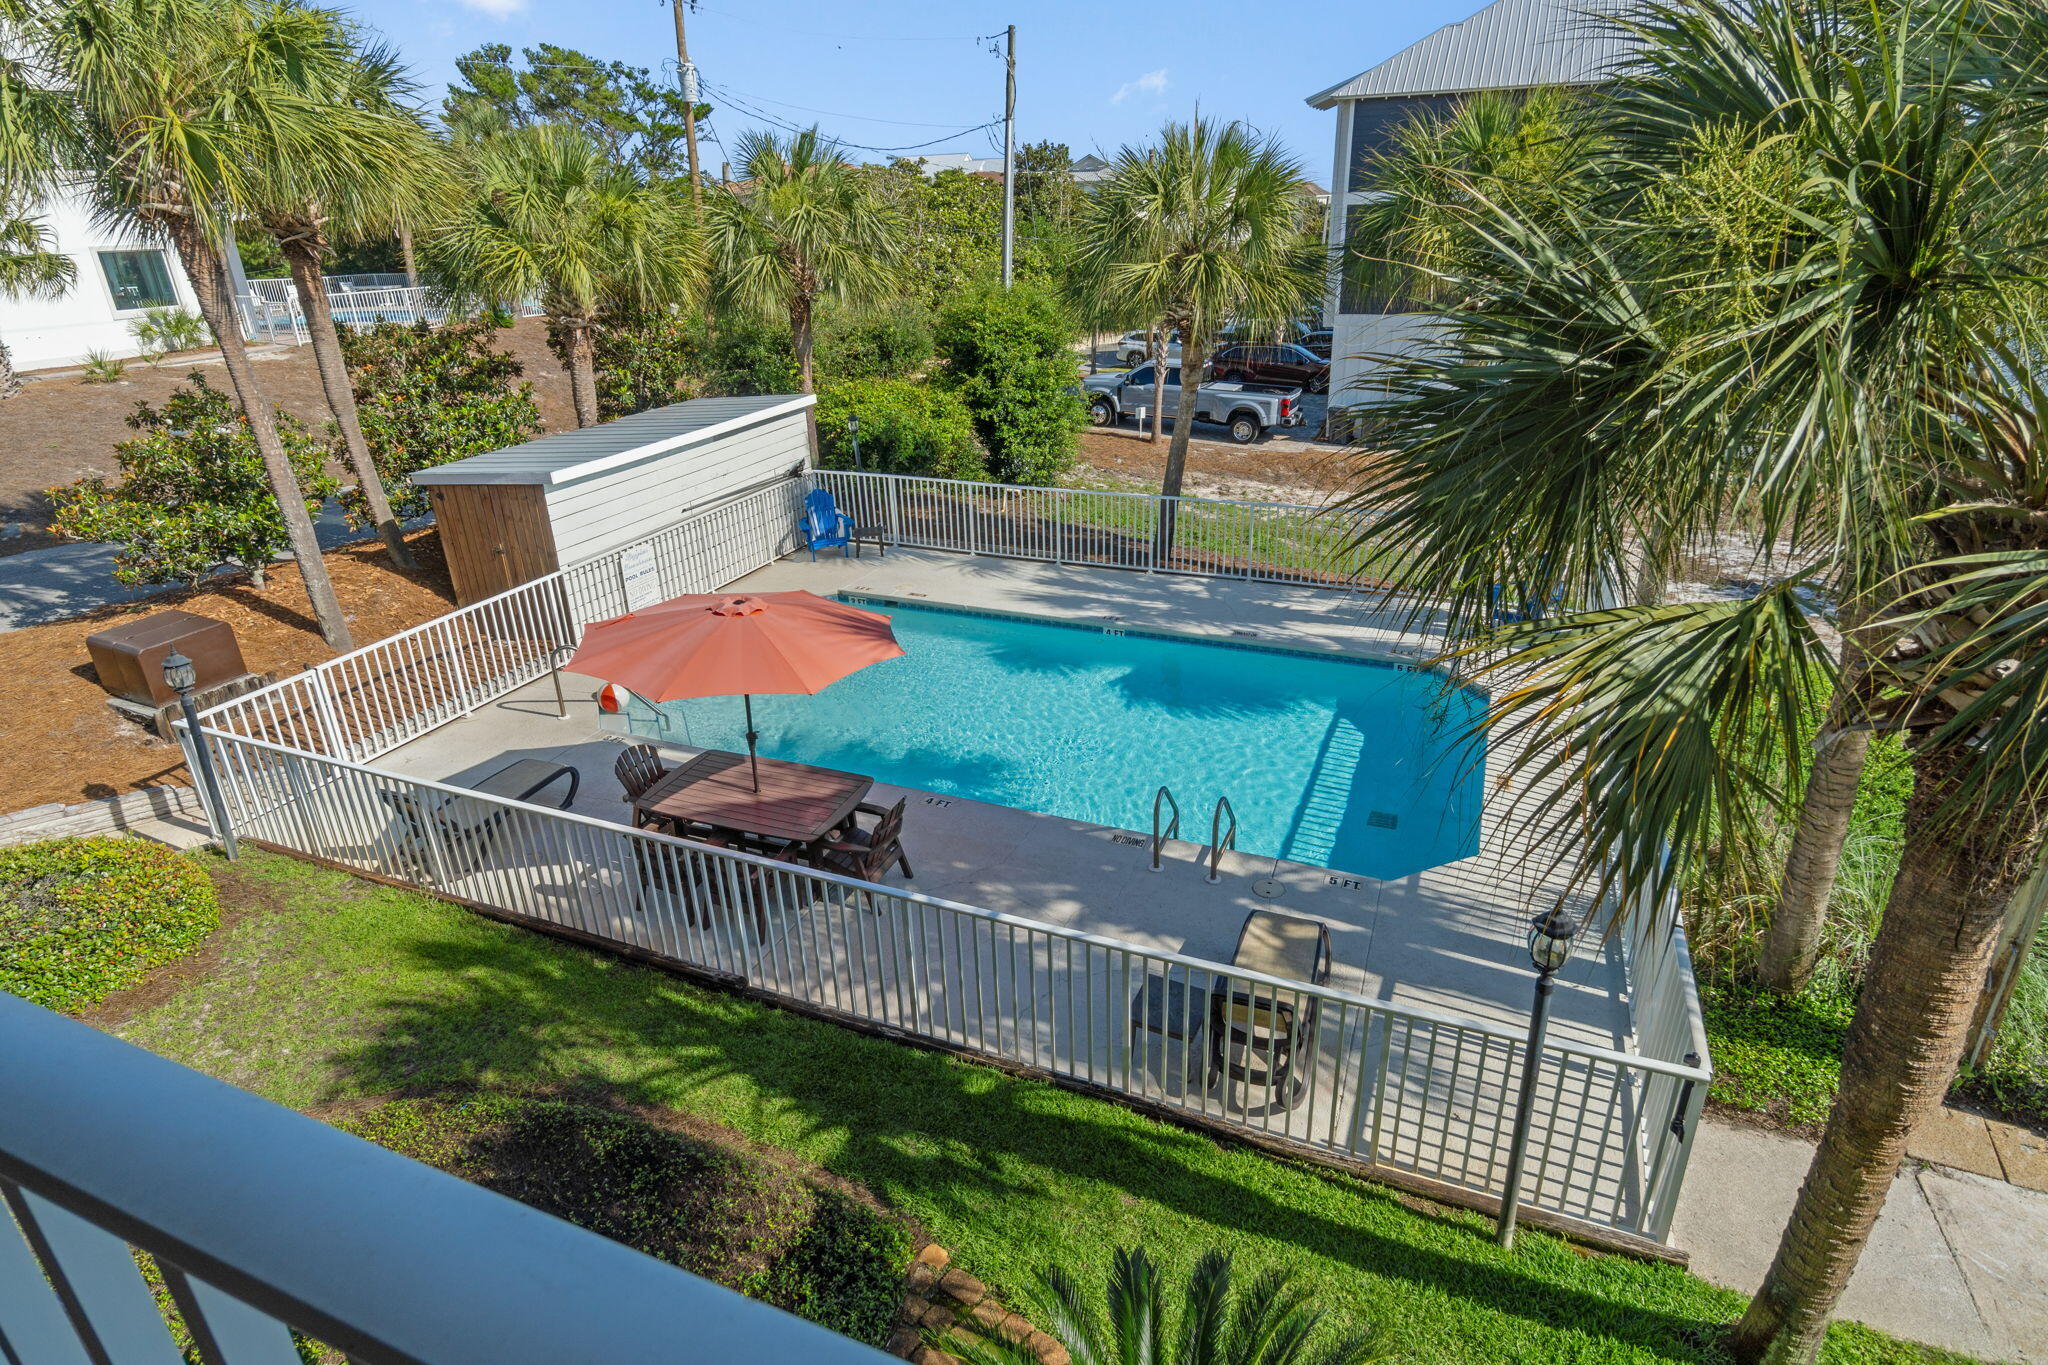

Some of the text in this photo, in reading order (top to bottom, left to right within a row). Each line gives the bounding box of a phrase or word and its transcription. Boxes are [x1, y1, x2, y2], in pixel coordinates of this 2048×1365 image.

[625, 566, 655, 582] POOL RULES
[1114, 629, 1124, 637] FT
[926, 797, 952, 808] 4 FT
[1112, 834, 1145, 847] NO DIVING
[1329, 876, 1339, 885] 5
